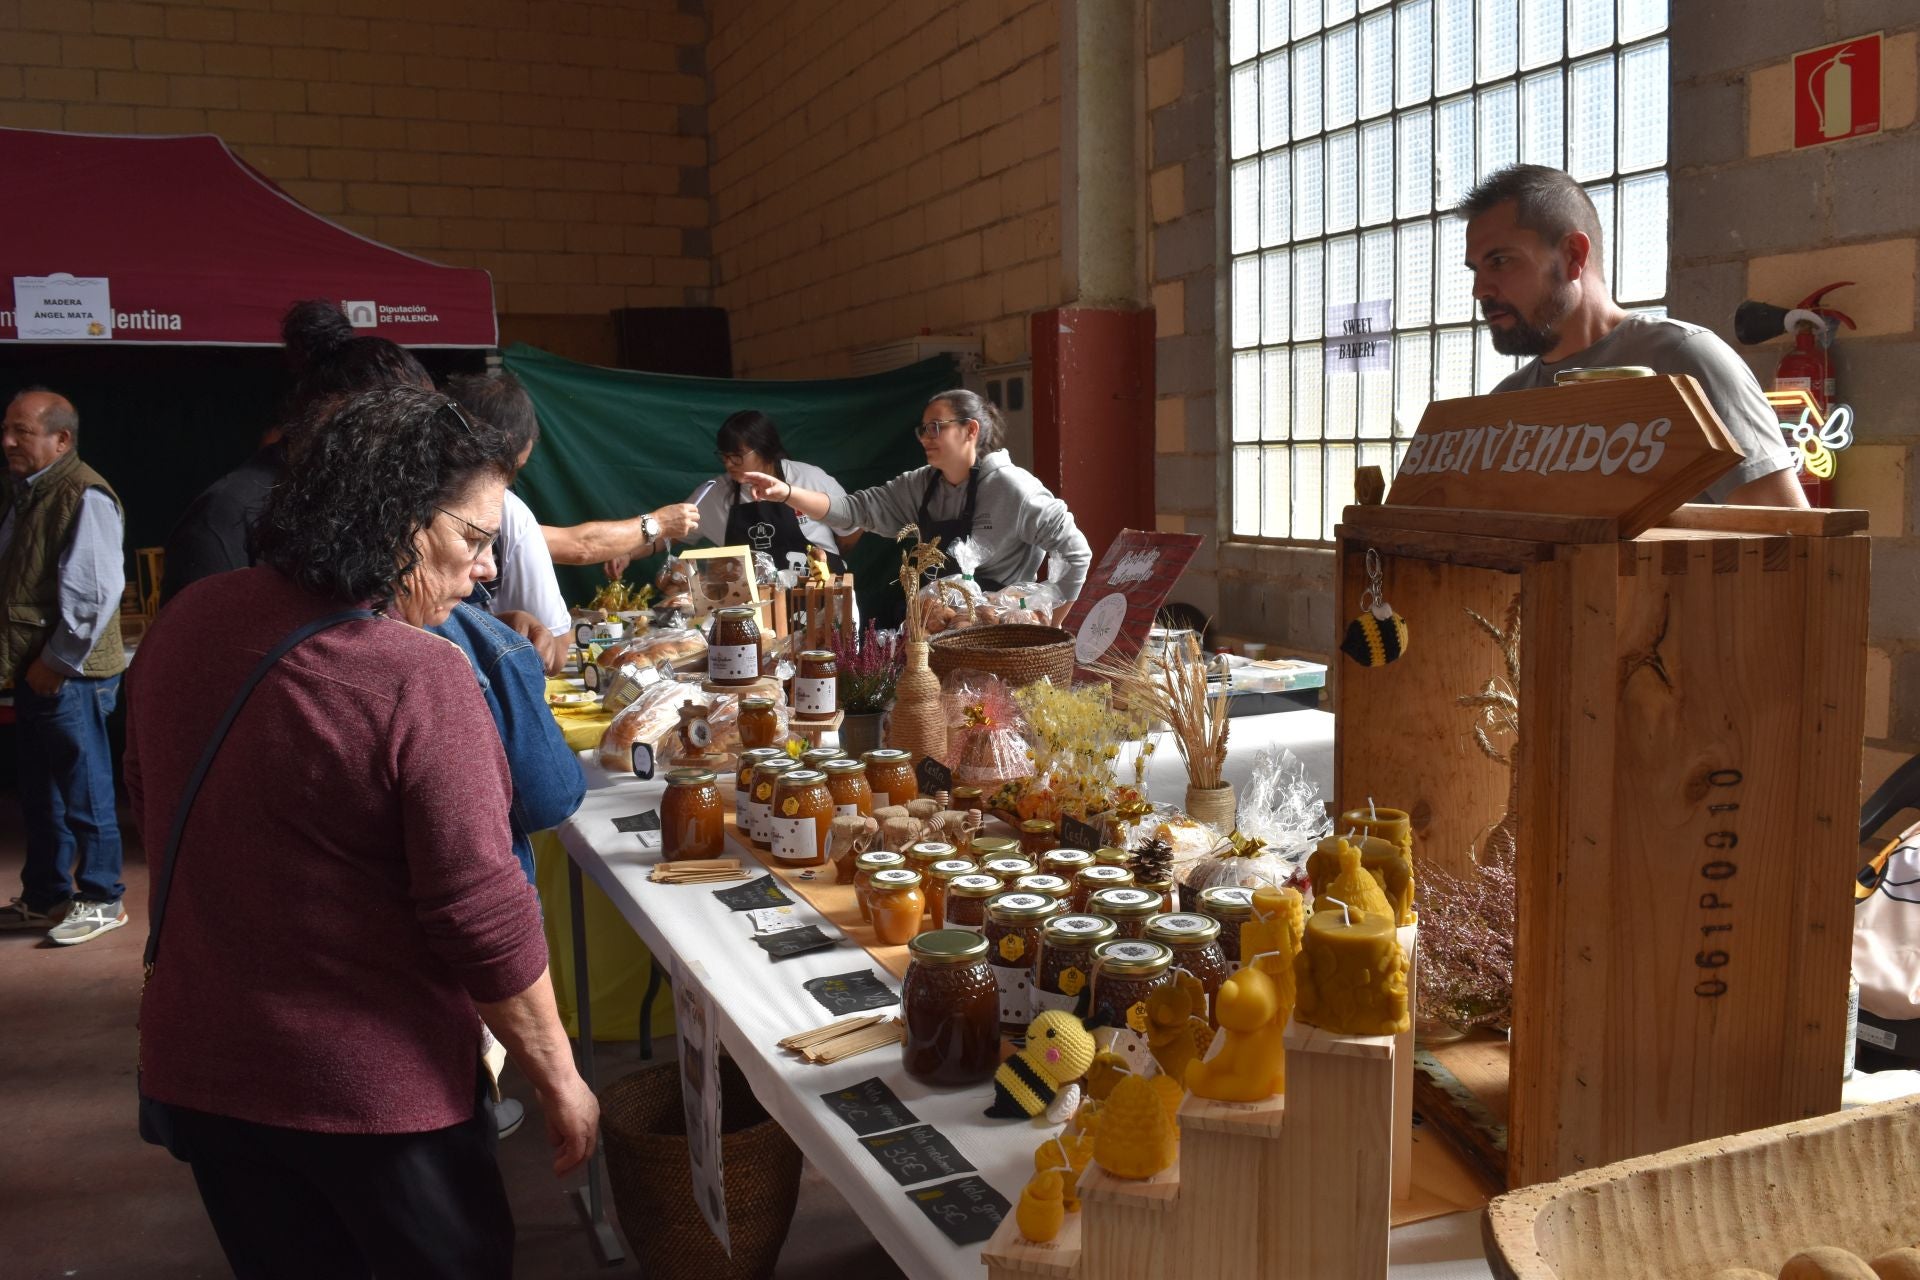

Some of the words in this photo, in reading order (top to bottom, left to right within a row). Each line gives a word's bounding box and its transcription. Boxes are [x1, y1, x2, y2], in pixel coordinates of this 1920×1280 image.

[43, 298, 82, 306] MADERA
[379, 304, 427, 315] Diputación
[111, 308, 182, 331] lentina
[380, 315, 393, 323] DE
[394, 314, 439, 322] PALENCIA
[1343, 317, 1373, 336] SWEET
[1338, 341, 1377, 360] BAKERY
[1399, 416, 1672, 477] BIENVENIDOS
[957, 1180, 986, 1202] Vela
